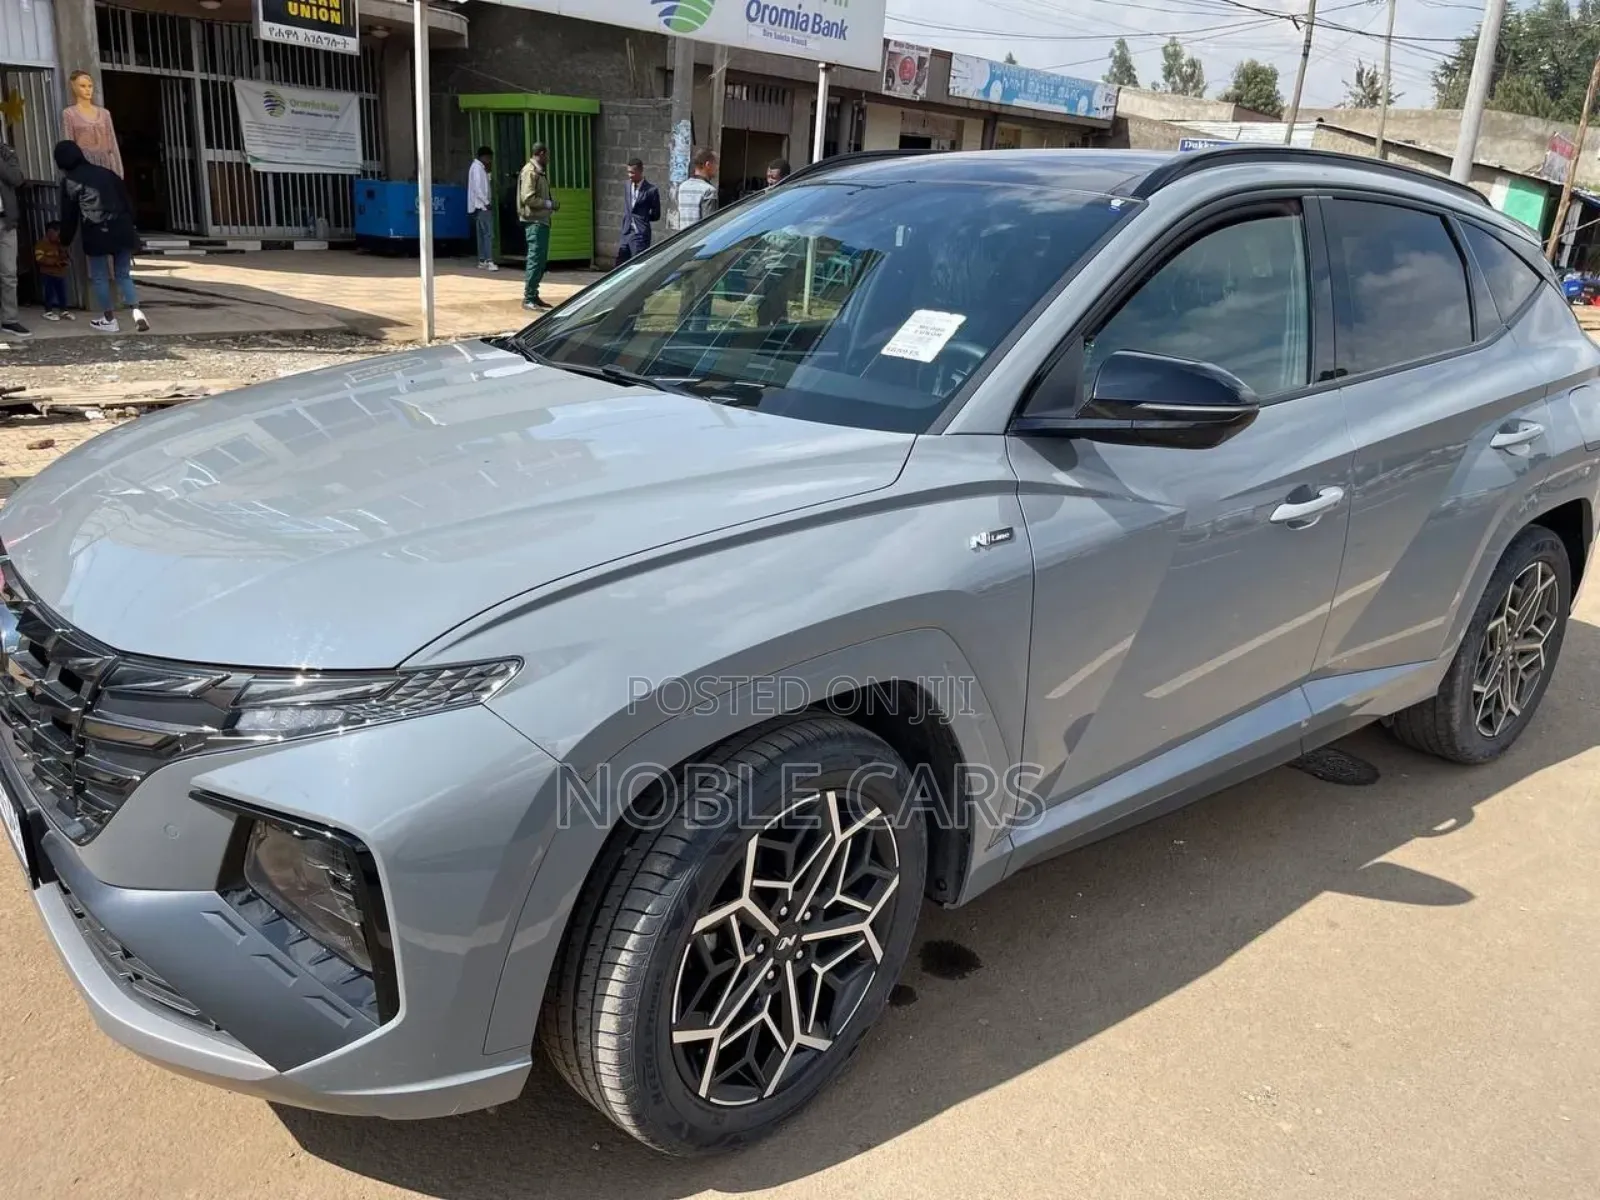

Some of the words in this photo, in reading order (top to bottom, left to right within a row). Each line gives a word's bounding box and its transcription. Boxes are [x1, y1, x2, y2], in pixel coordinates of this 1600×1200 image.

[287, 2, 341, 25] UNION
[745, 0, 809, 32] Oromia
[811, 12, 849, 41] Bank
